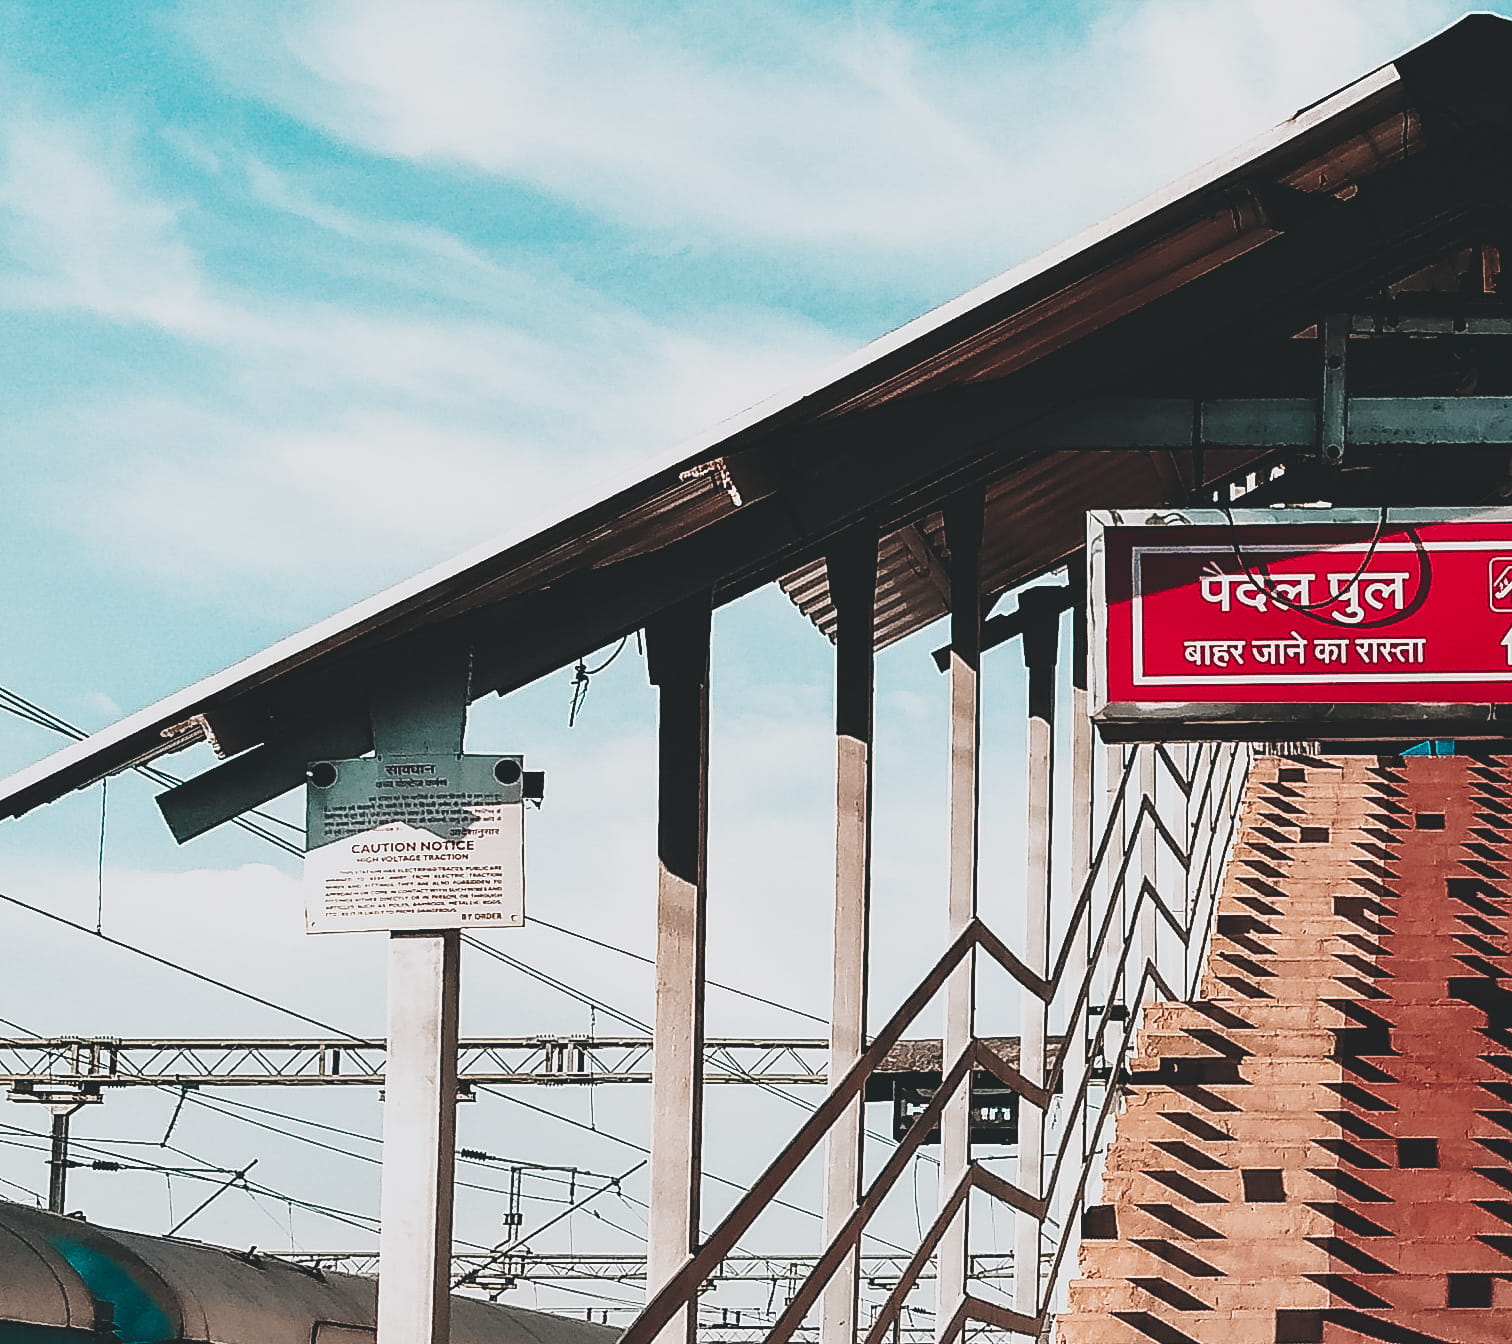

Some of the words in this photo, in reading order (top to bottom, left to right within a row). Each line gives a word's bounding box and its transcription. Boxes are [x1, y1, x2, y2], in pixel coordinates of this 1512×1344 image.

[1327, 571, 1410, 624] पुल
[1183, 640, 1246, 667] बाहर
[1251, 631, 1308, 665] जाने
[1314, 639, 1349, 664] का
[1355, 638, 1427, 664] रास्ता
[385, 764, 437, 775] सावधान
[351, 842, 416, 855] CAUTION
[420, 840, 475, 852] NOTICE
[381, 854, 421, 863] VOLTAGE
[423, 853, 469, 861] TRACTION
